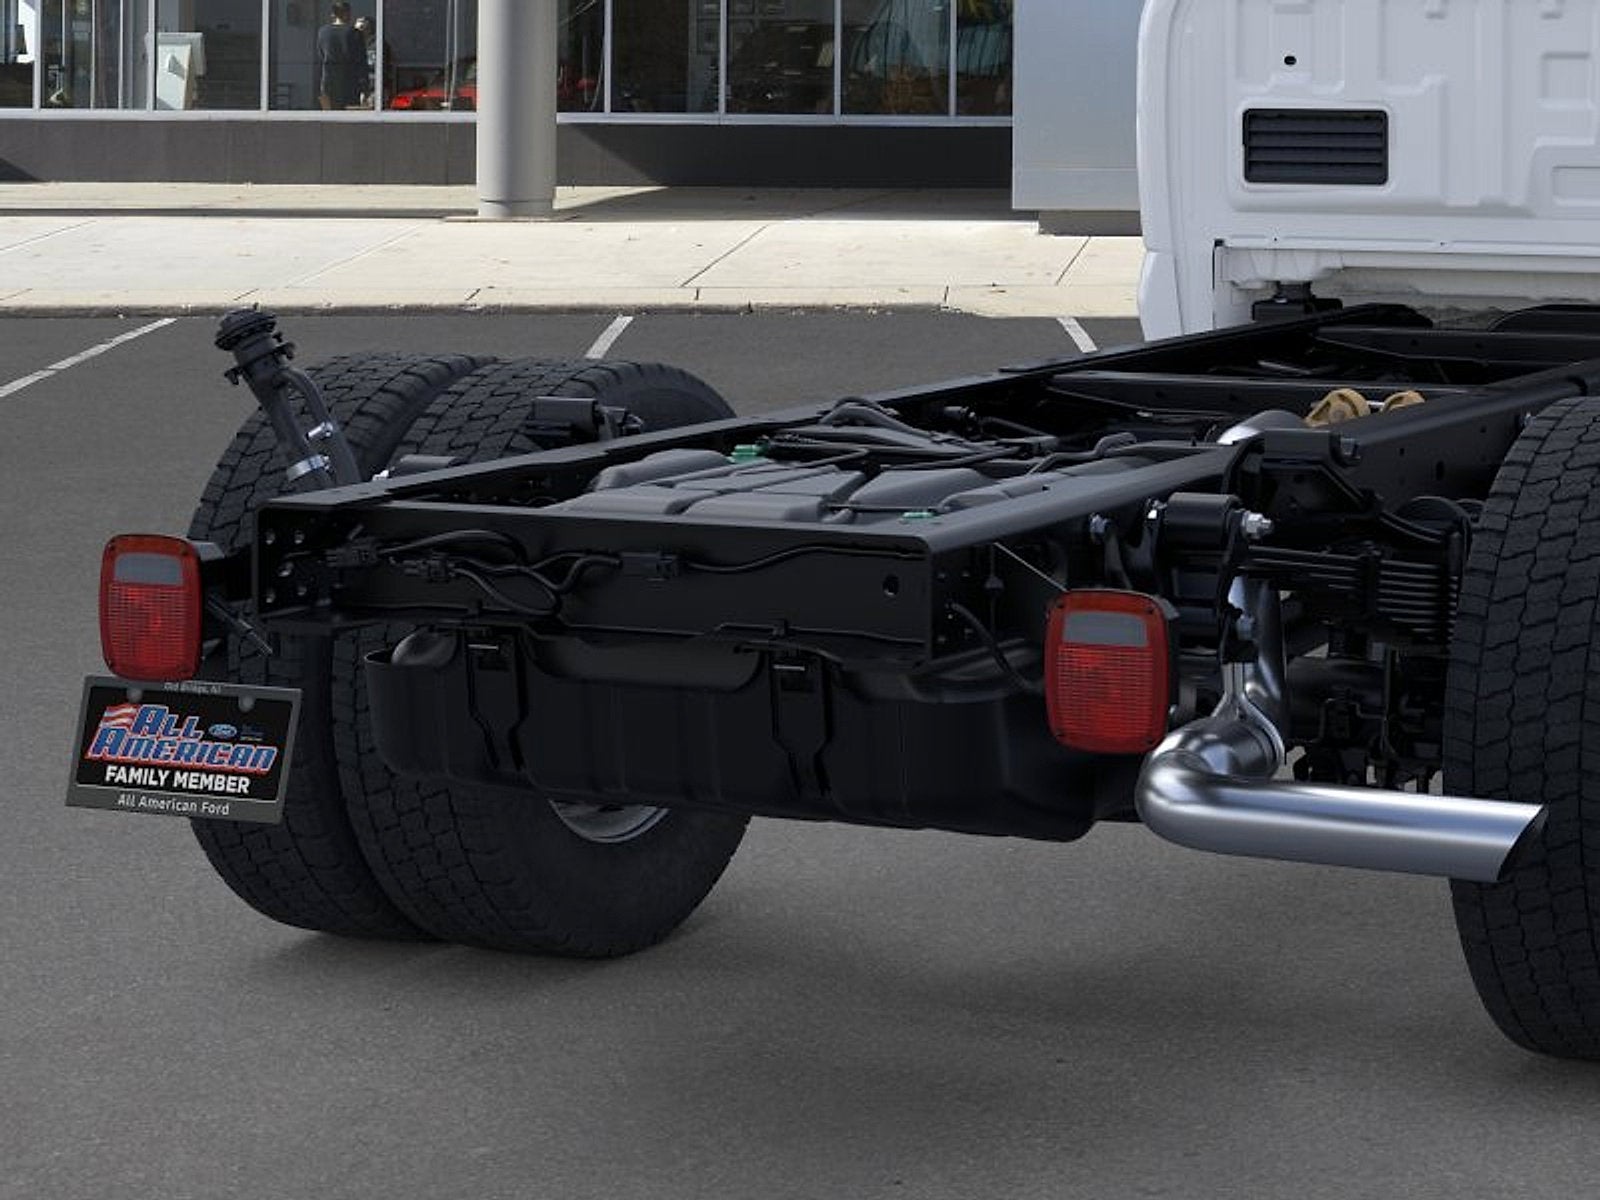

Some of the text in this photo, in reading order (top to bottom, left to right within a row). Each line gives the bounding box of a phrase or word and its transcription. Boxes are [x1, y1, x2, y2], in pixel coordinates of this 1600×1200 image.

[105, 765, 250, 794] FAMILY MEMBER
[118, 793, 230, 816] All American Ford
